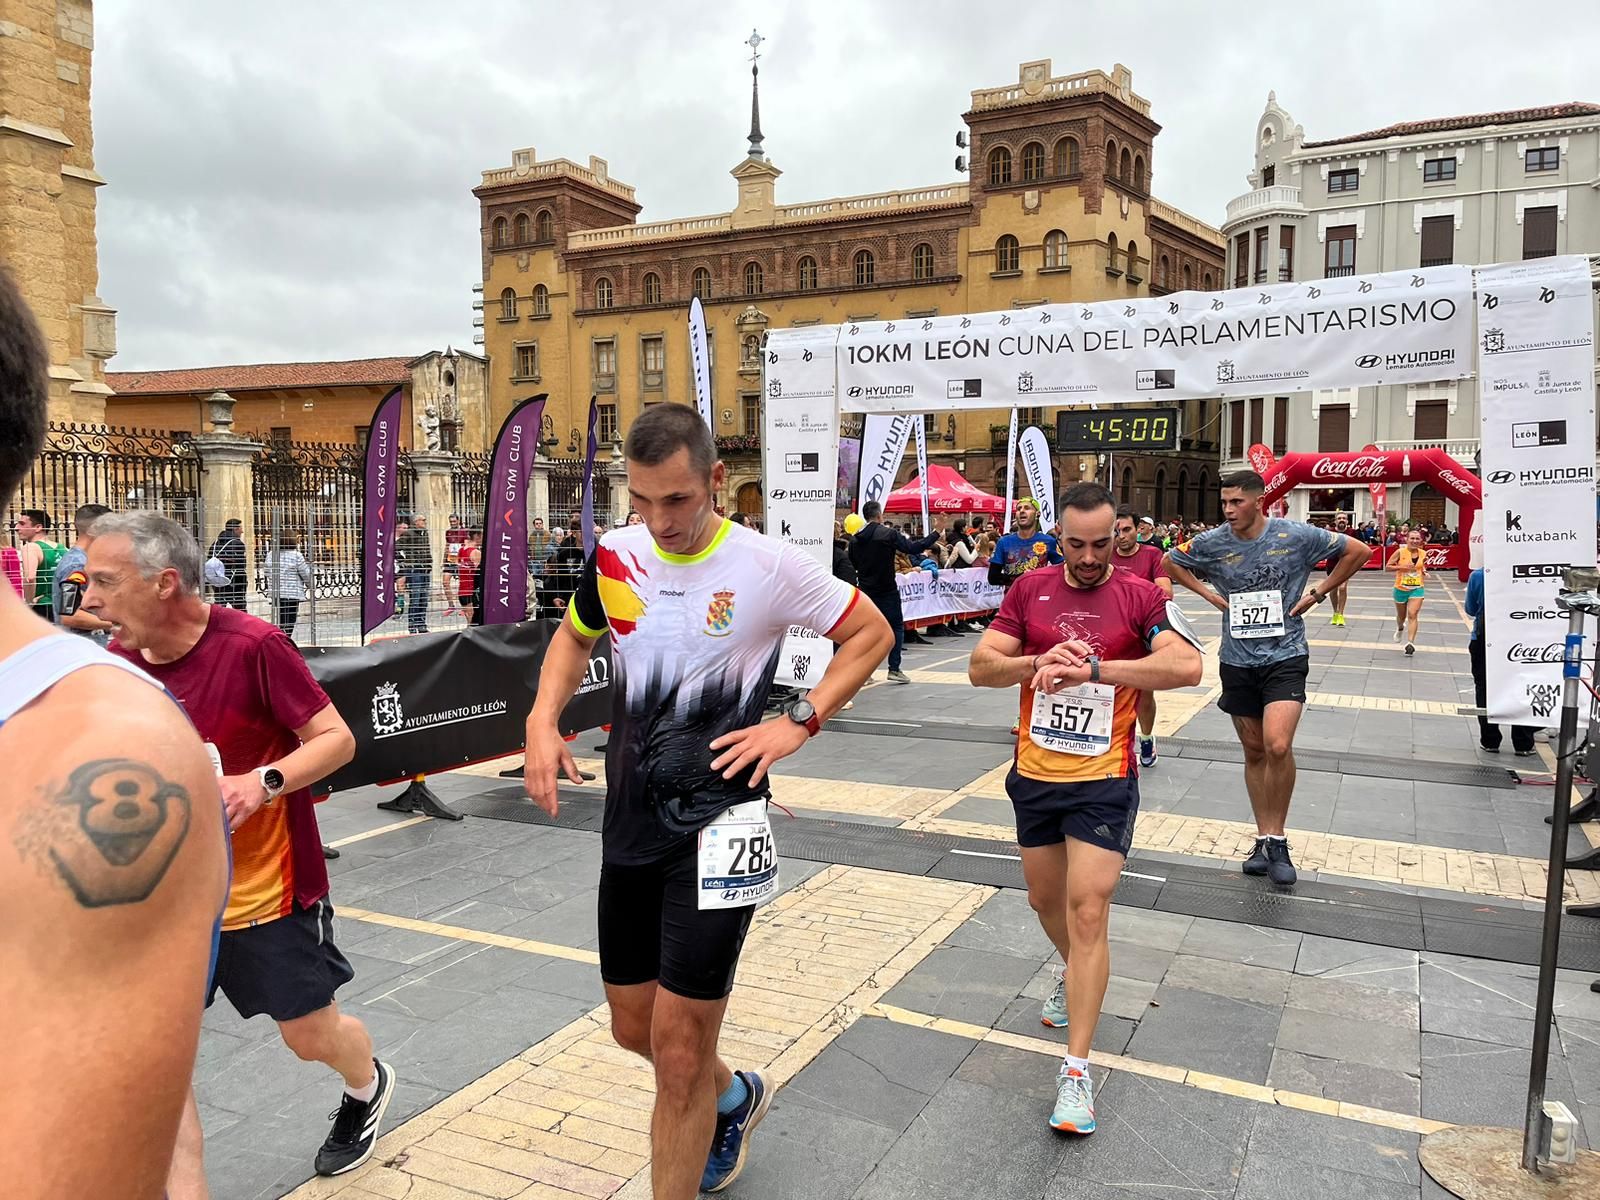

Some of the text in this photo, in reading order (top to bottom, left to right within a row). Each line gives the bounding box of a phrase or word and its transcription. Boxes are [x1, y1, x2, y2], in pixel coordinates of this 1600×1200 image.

[848, 299, 1456, 365] 10KM LEÓN CUNA DEL PARLAMENTARISMO
[1506, 340, 1561, 351] AYUNTAMIENTO
[1386, 349, 1455, 366] HYUNDAI
[1386, 359, 1455, 371] Lemauto Automoción
[1138, 376, 1154, 384] LEÓN
[1236, 372, 1281, 381] AYUNTAMIENTO
[865, 385, 914, 396] HYUNDAI
[1493, 382, 1530, 391] IMPULSA
[1534, 387, 1558, 395] Castilla
[1515, 429, 1537, 438] LEÓN
[1025, 439, 1045, 499] HYUNDAI
[1312, 456, 1390, 478] Coca-Cola
[1520, 467, 1593, 481] HYUNDAI
[790, 489, 832, 499] HYUNDAI
[376, 420, 389, 604] ALTAFIT GYM CLUB
[499, 424, 522, 607] ALTAFIT GYM CLUB
[1506, 530, 1577, 543] kutxabank
[659, 589, 686, 597] mobel
[1242, 606, 1269, 624] 527
[1526, 684, 1561, 696] KAM
[405, 699, 507, 729] AYUNTAMIENTO DE LEÓN
[1050, 703, 1094, 733] 557
[1057, 739, 1096, 750] HYUNDAI
[728, 834, 772, 876] 285
